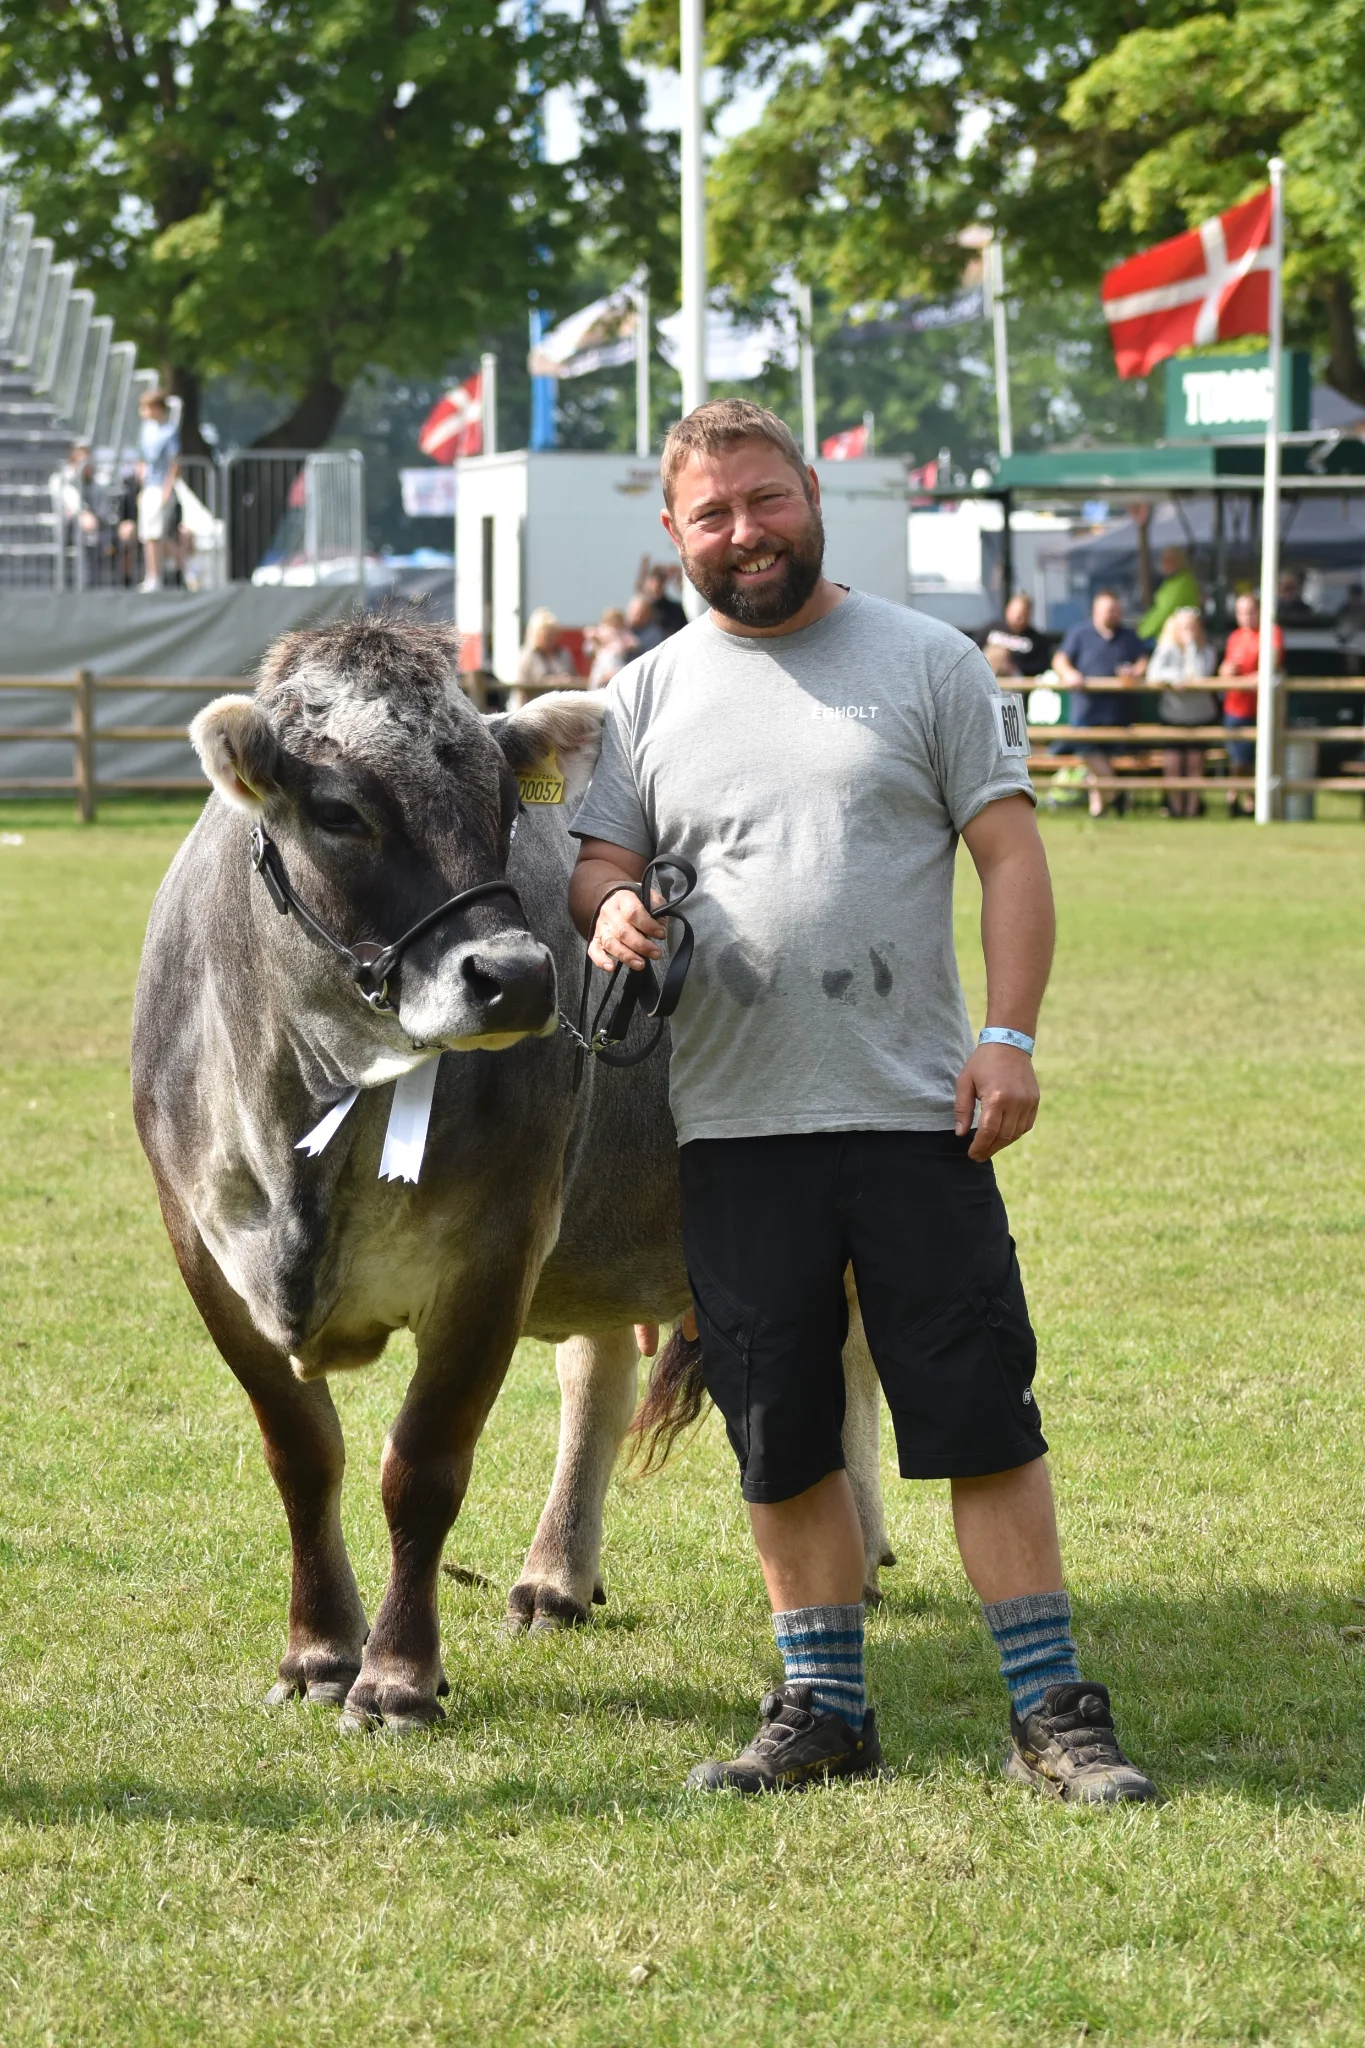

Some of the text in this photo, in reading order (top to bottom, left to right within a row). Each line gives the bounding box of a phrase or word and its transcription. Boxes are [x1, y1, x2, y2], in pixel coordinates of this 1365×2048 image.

[811, 705, 879, 720] EGHOLT
[1001, 704, 1022, 748] 602
[520, 779, 562, 802] 00057
